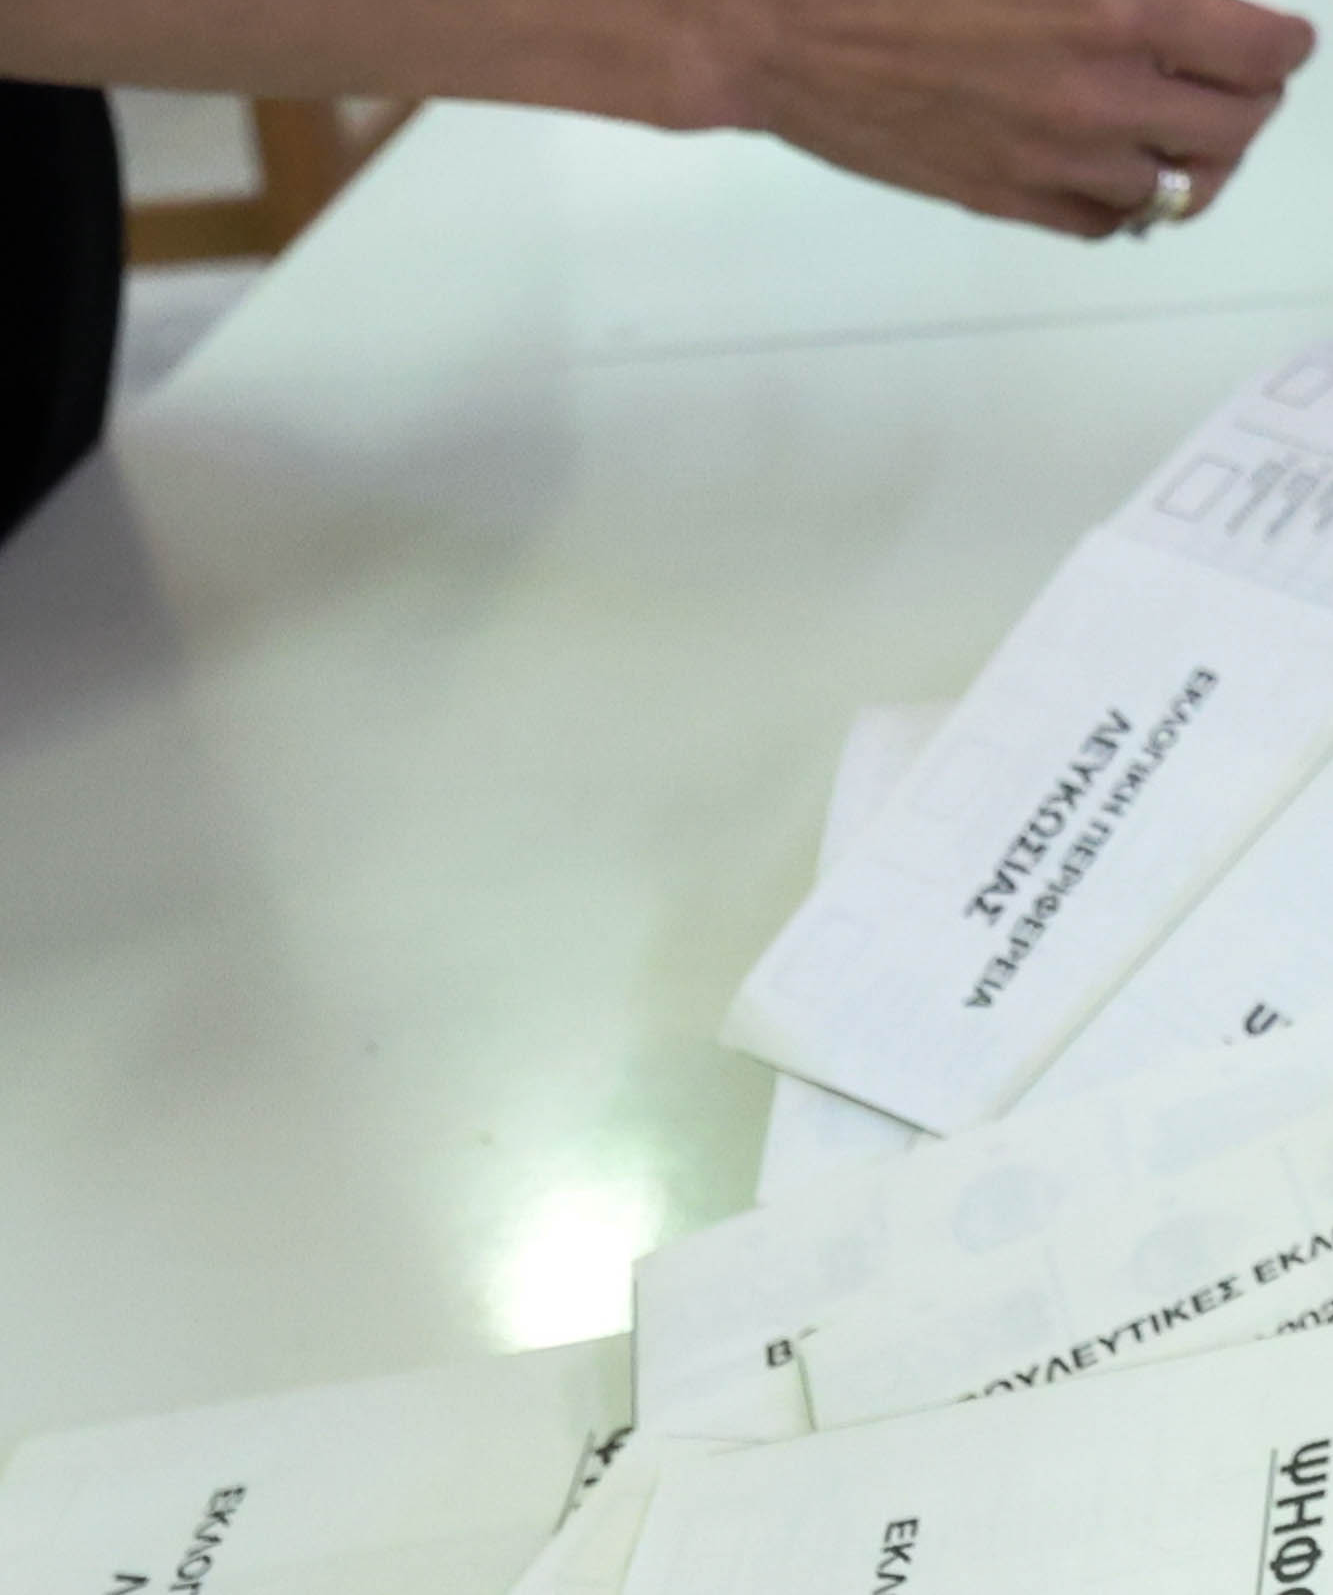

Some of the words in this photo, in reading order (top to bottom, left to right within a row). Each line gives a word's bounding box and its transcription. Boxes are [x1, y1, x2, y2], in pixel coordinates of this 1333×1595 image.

[965, 708, 1131, 927] ΛΕΥΚΩΣΙΑΣ
[1102, 665, 1218, 816] ΕΚΛΟΓΙΚΗ
[964, 819, 1113, 1009] ΠΕΡΙΦΕΡΕΙΑ
[955, 1274, 1245, 1404] ΟΥΛΕΥΤΙΚΕΣ
[1270, 1439, 1331, 1595] ΨΗΦ
